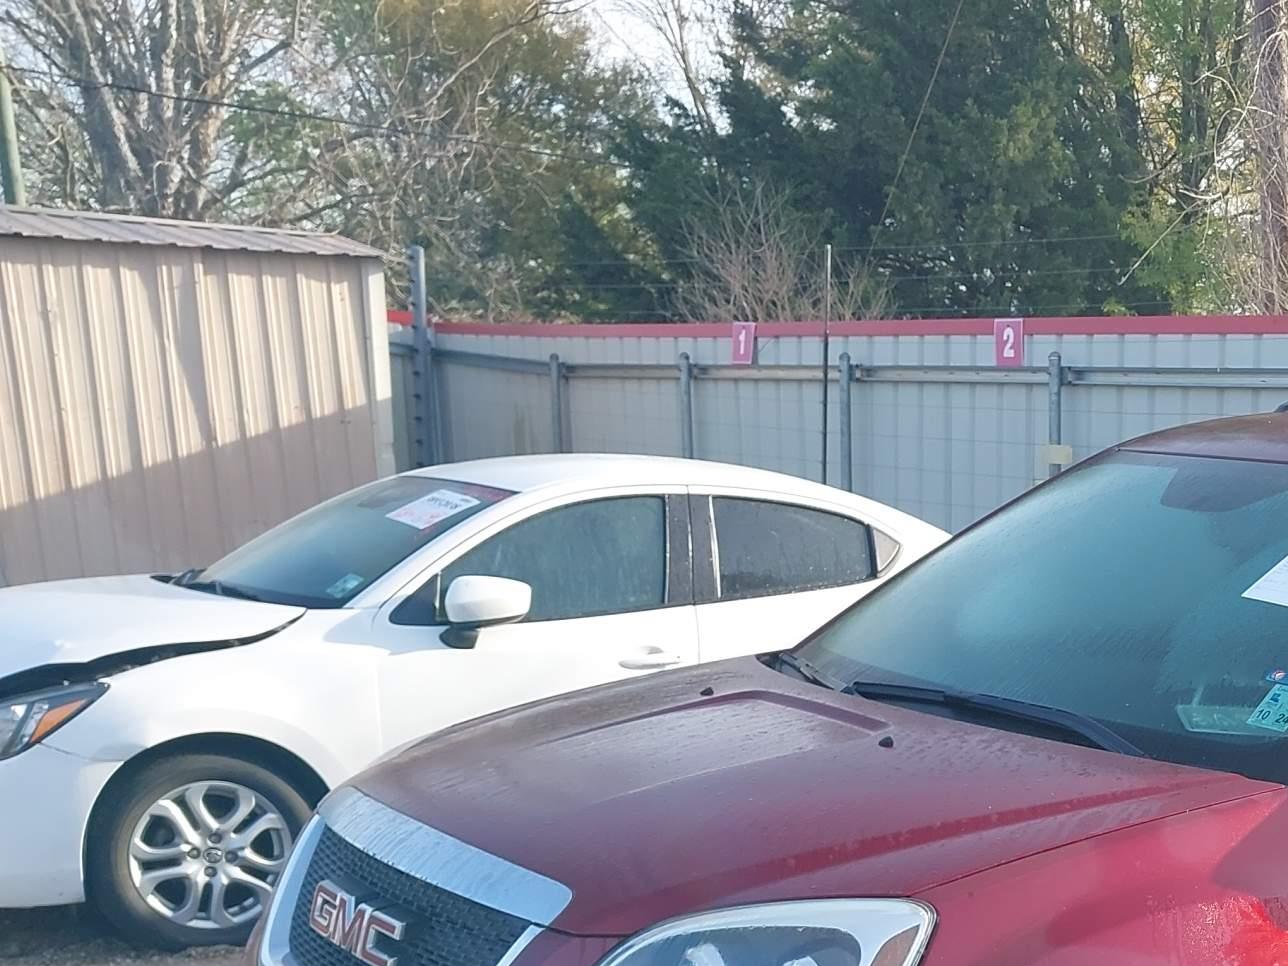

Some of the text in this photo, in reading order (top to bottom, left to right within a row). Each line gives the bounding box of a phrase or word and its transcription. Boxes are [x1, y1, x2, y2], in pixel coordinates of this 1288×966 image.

[739, 328, 746, 355] 1
[1003, 326, 1015, 357] 2
[1256, 708, 1272, 720] 10
